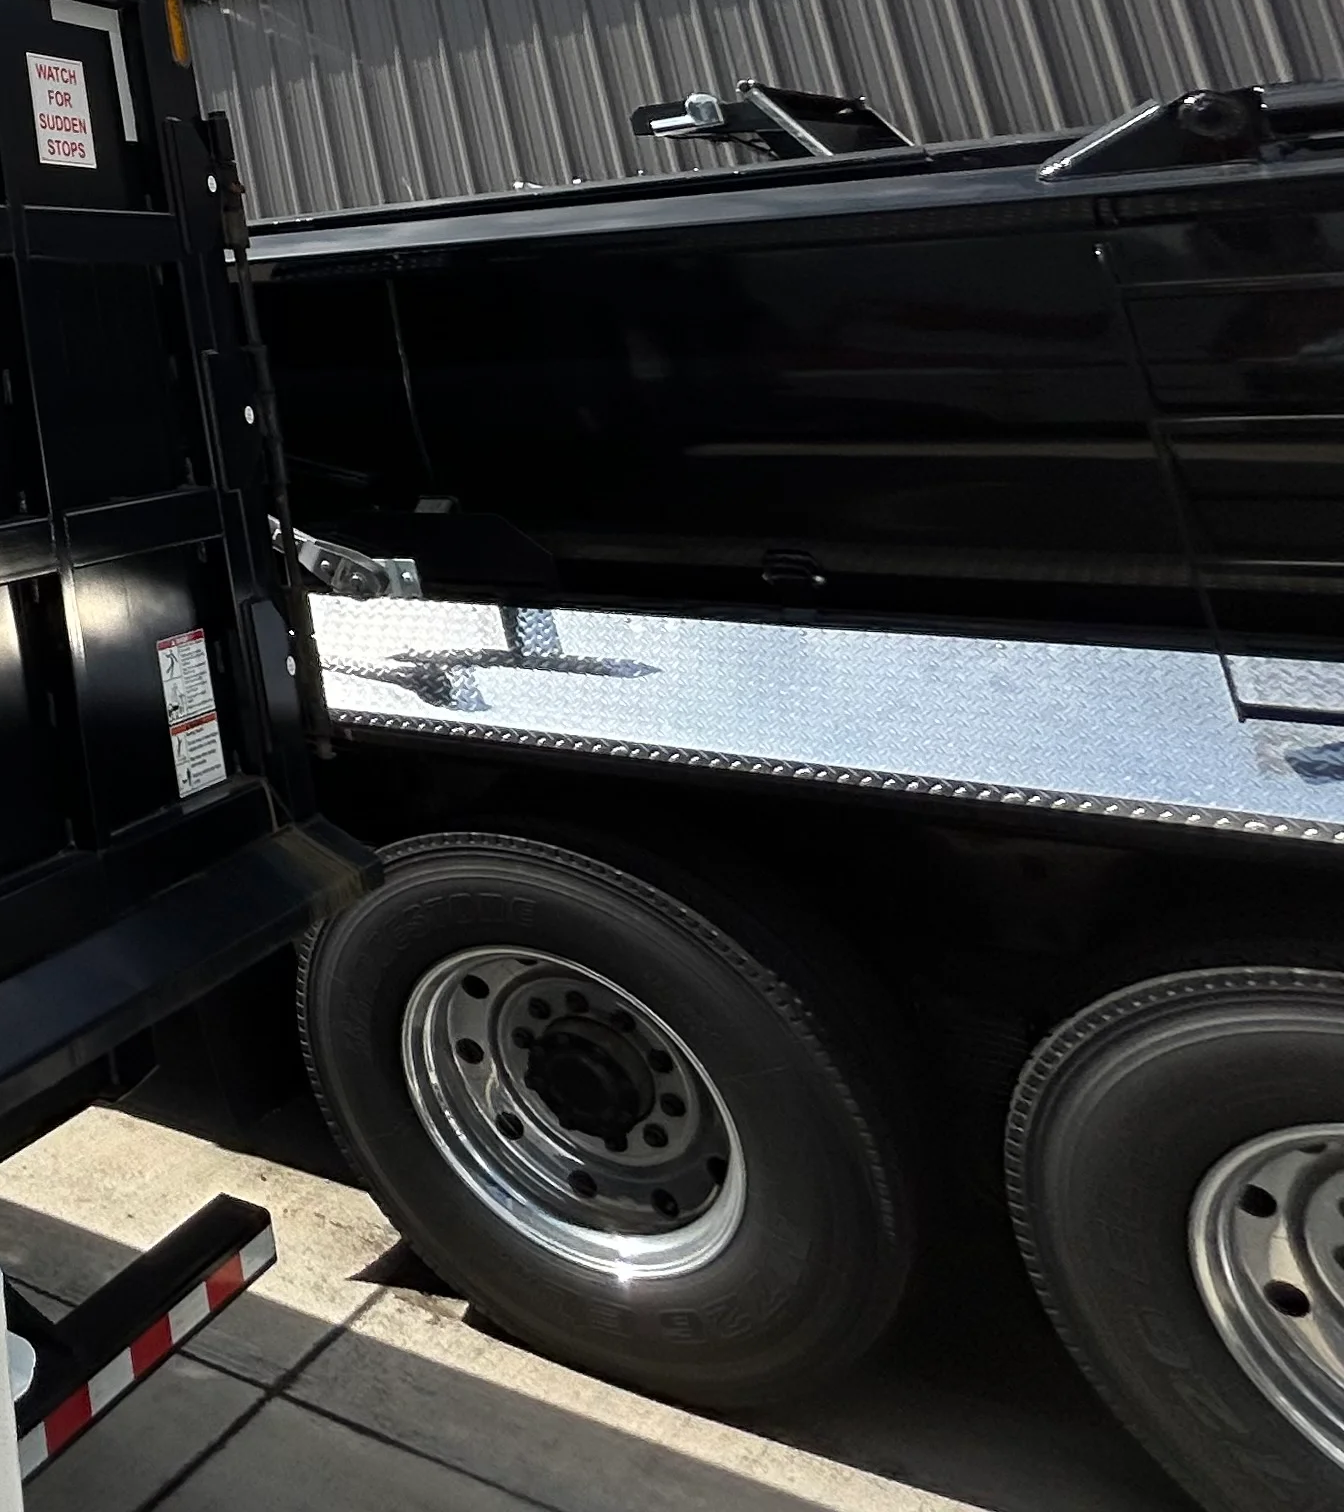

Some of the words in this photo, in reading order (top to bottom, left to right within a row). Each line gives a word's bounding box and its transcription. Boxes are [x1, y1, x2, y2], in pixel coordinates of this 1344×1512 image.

[35, 63, 77, 85] WATCH
[48, 90, 73, 108] FOR
[39, 113, 87, 135] SUDDEN
[47, 139, 86, 159] STOPS
